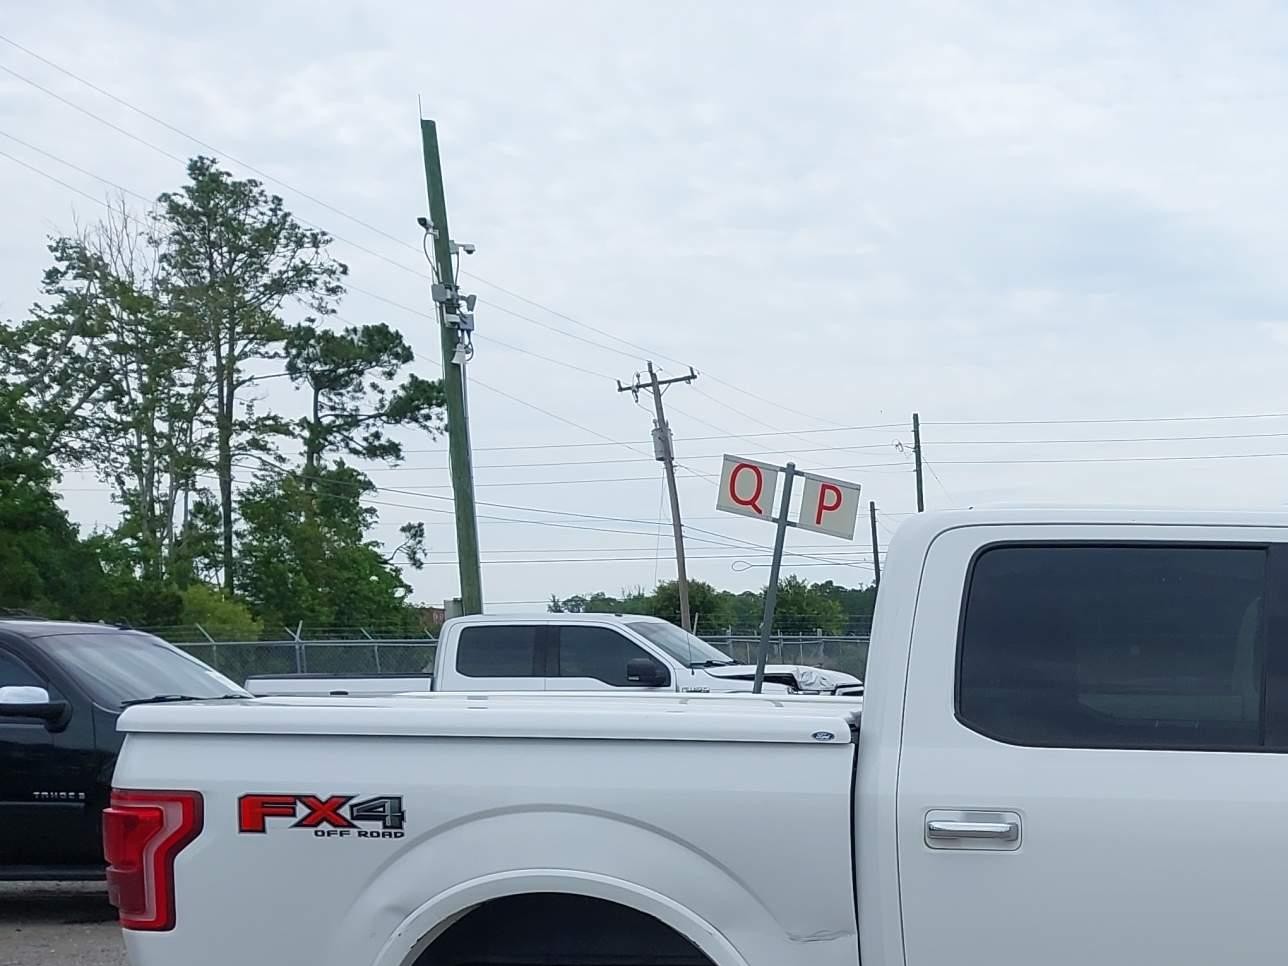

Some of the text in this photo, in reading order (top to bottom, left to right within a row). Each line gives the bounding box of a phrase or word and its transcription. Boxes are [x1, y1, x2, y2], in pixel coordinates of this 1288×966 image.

[729, 462, 764, 514] Q
[815, 482, 843, 525] P
[238, 793, 406, 833] FX4
[314, 830, 405, 839] OFF ROAD
